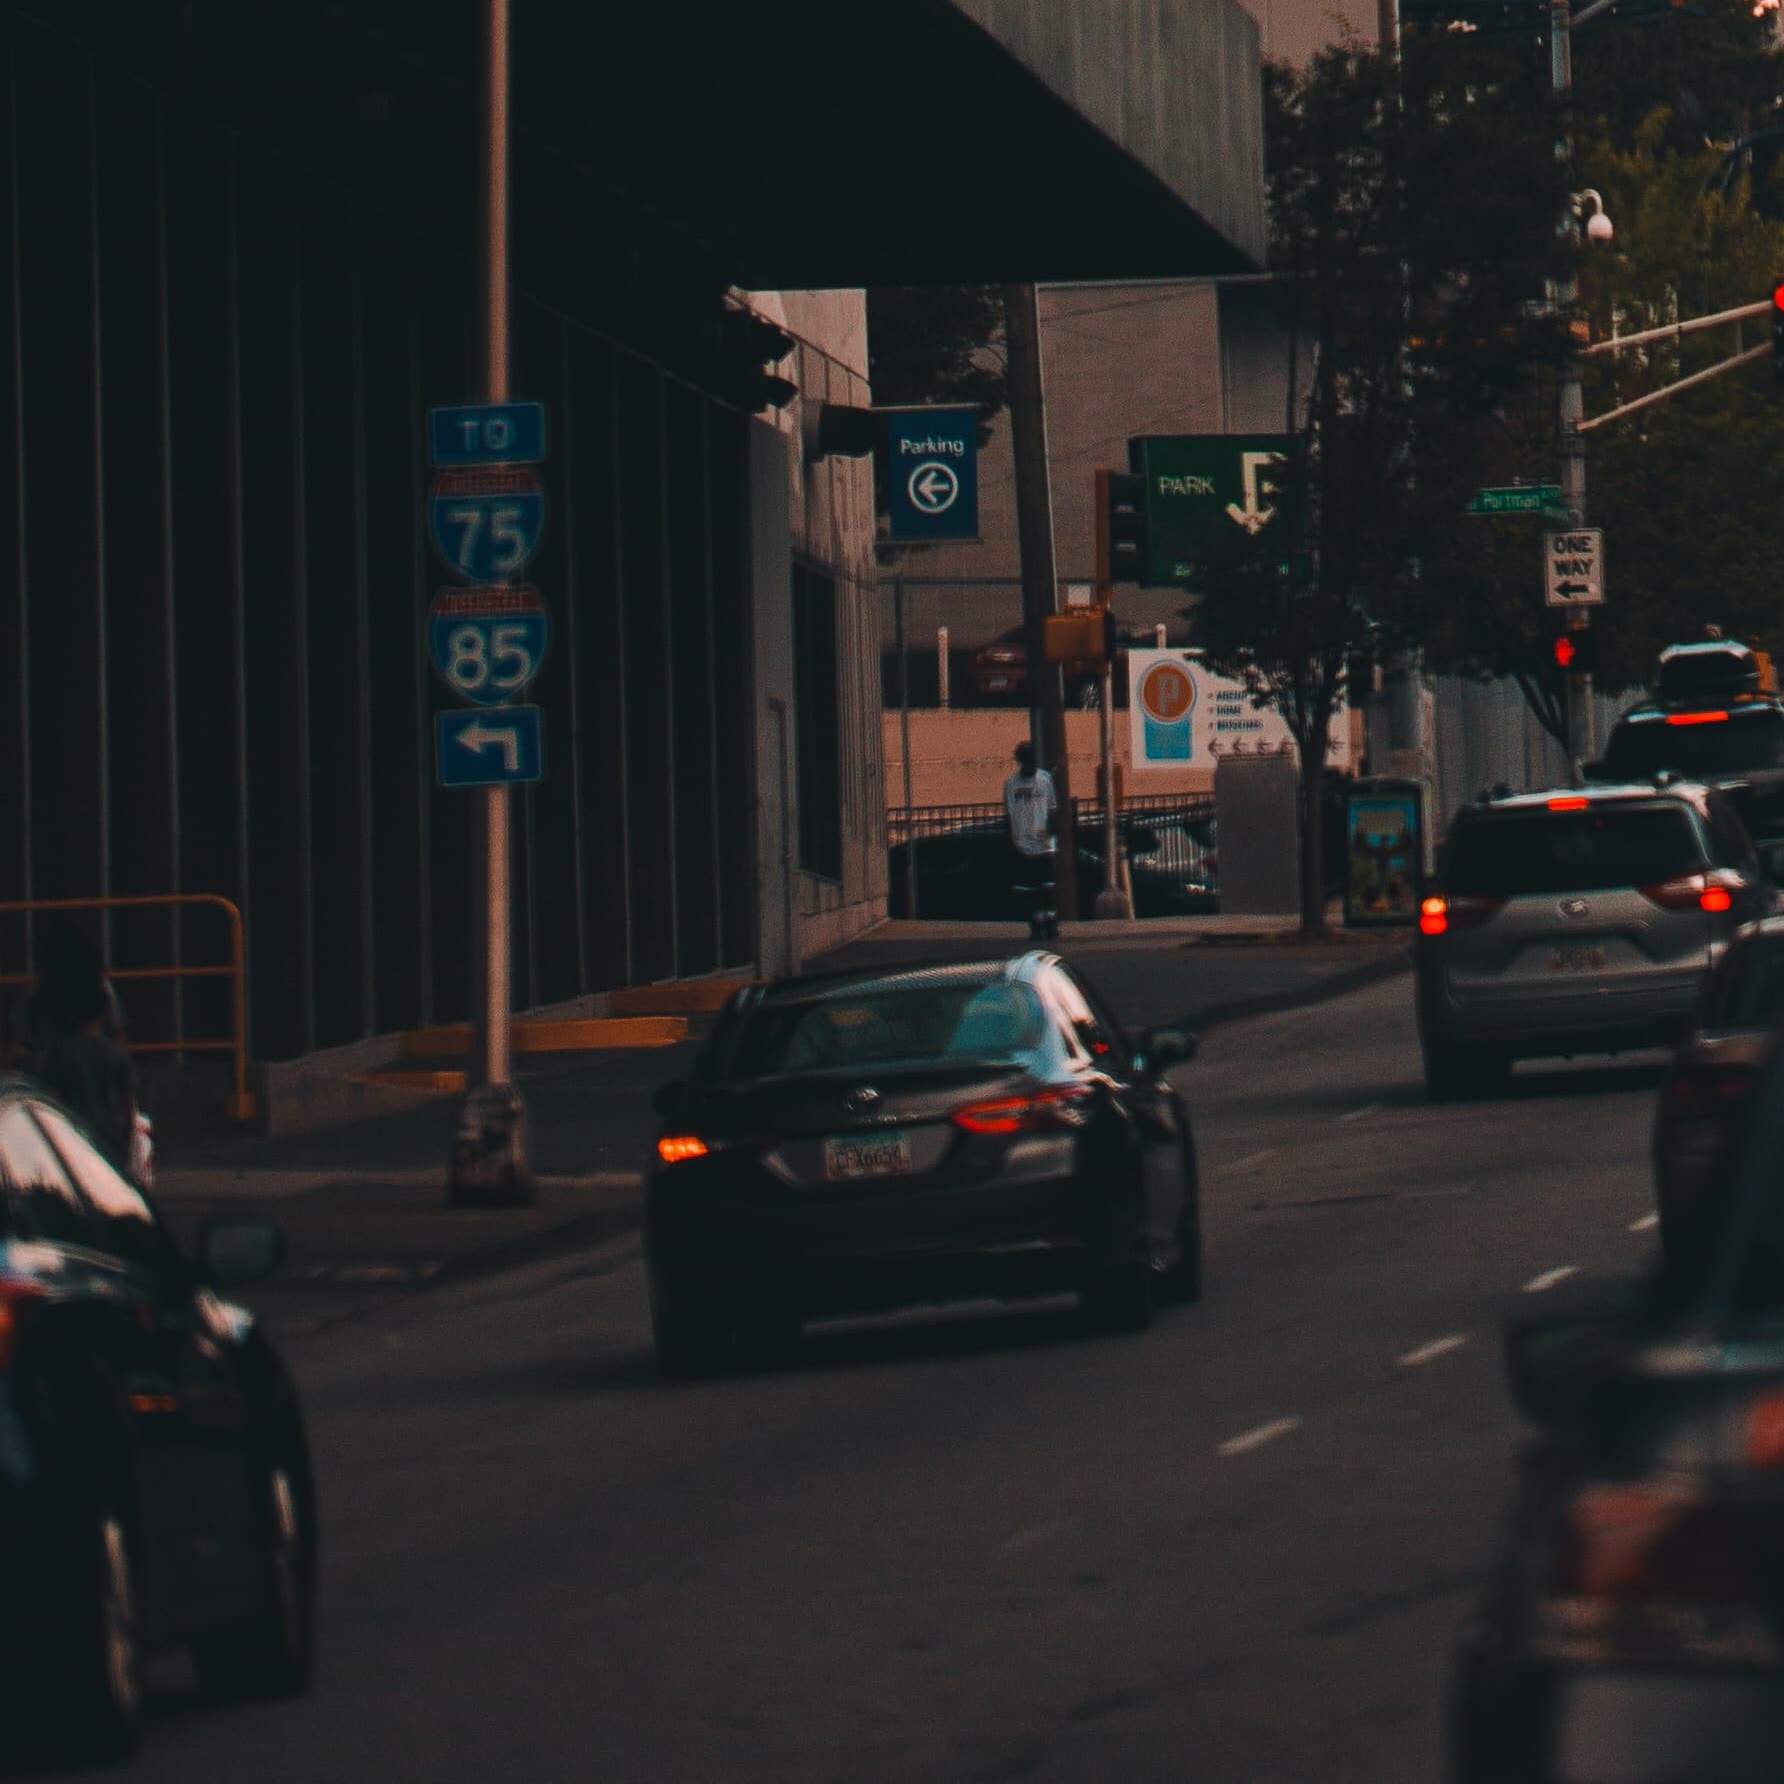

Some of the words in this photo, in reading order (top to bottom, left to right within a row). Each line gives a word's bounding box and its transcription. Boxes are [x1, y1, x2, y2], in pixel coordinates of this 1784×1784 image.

[457, 418, 511, 451] TO
[900, 436, 965, 457] Parking
[1158, 476, 1216, 496] PARK
[449, 507, 527, 575] 75
[1554, 536, 1592, 554] ONE
[1554, 559, 1594, 576] WAY
[448, 625, 532, 689] 85
